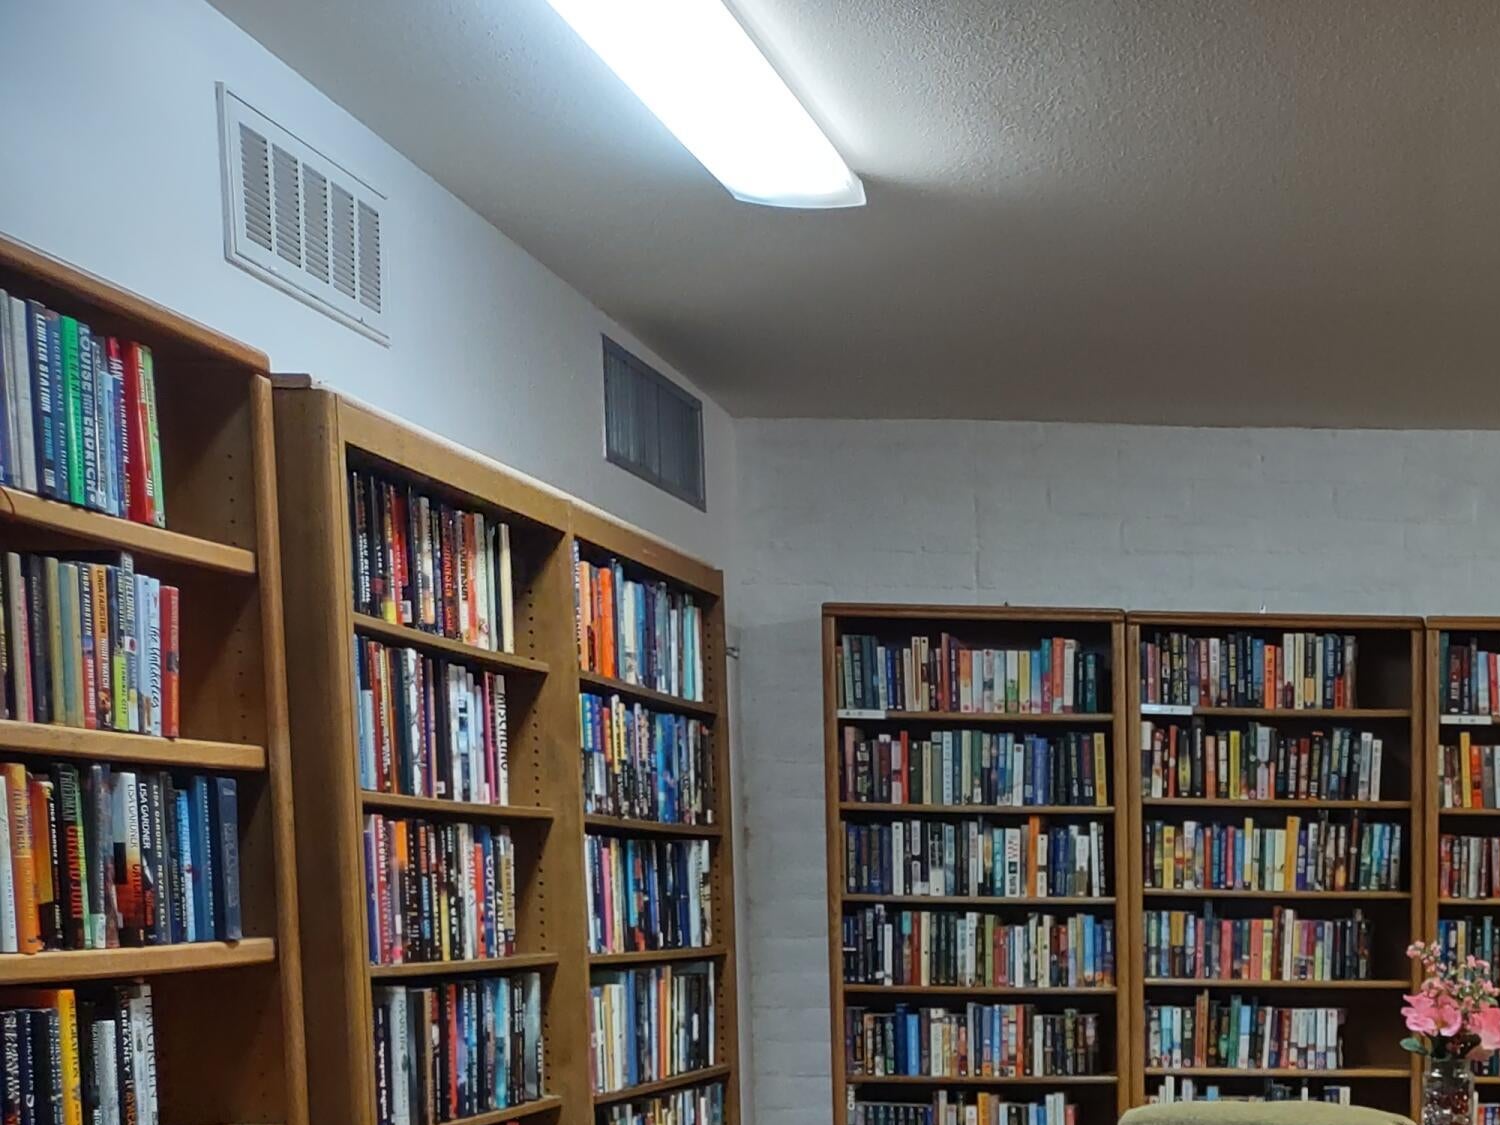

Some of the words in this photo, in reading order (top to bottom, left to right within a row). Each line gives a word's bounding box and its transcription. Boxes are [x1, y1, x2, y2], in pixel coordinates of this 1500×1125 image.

[79, 327, 91, 391] LOUISE
[39, 365, 52, 412] STATION
[56, 385, 64, 412] ONLY
[83, 417, 96, 491] ERDRICH
[84, 594, 92, 636] FAIRSTEIN
[125, 576, 136, 622] FIELDING
[98, 595, 106, 633] FAIRSTEIN
[102, 663, 110, 688] WATCH
[151, 626, 160, 641] The
[60, 771, 77, 821] FRIEDMAN
[128, 784, 136, 803] LISA
[139, 783, 148, 803] LISA
[14, 814, 26, 850] FRANCIS
[129, 805, 138, 848] GARDNER
[141, 805, 151, 849] GARDNER
[66, 825, 82, 880] GRAND
[69, 884, 84, 919] JURY
[69, 999, 77, 1021] SUE
[144, 994, 154, 1028] TIM
[70, 1023, 79, 1079] GRAFTON
[121, 1010, 130, 1072] GREANEY
[5, 1042, 14, 1101] GRAFTON
[147, 1034, 156, 1099] GREEN
[26, 1094, 35, 1107] S
